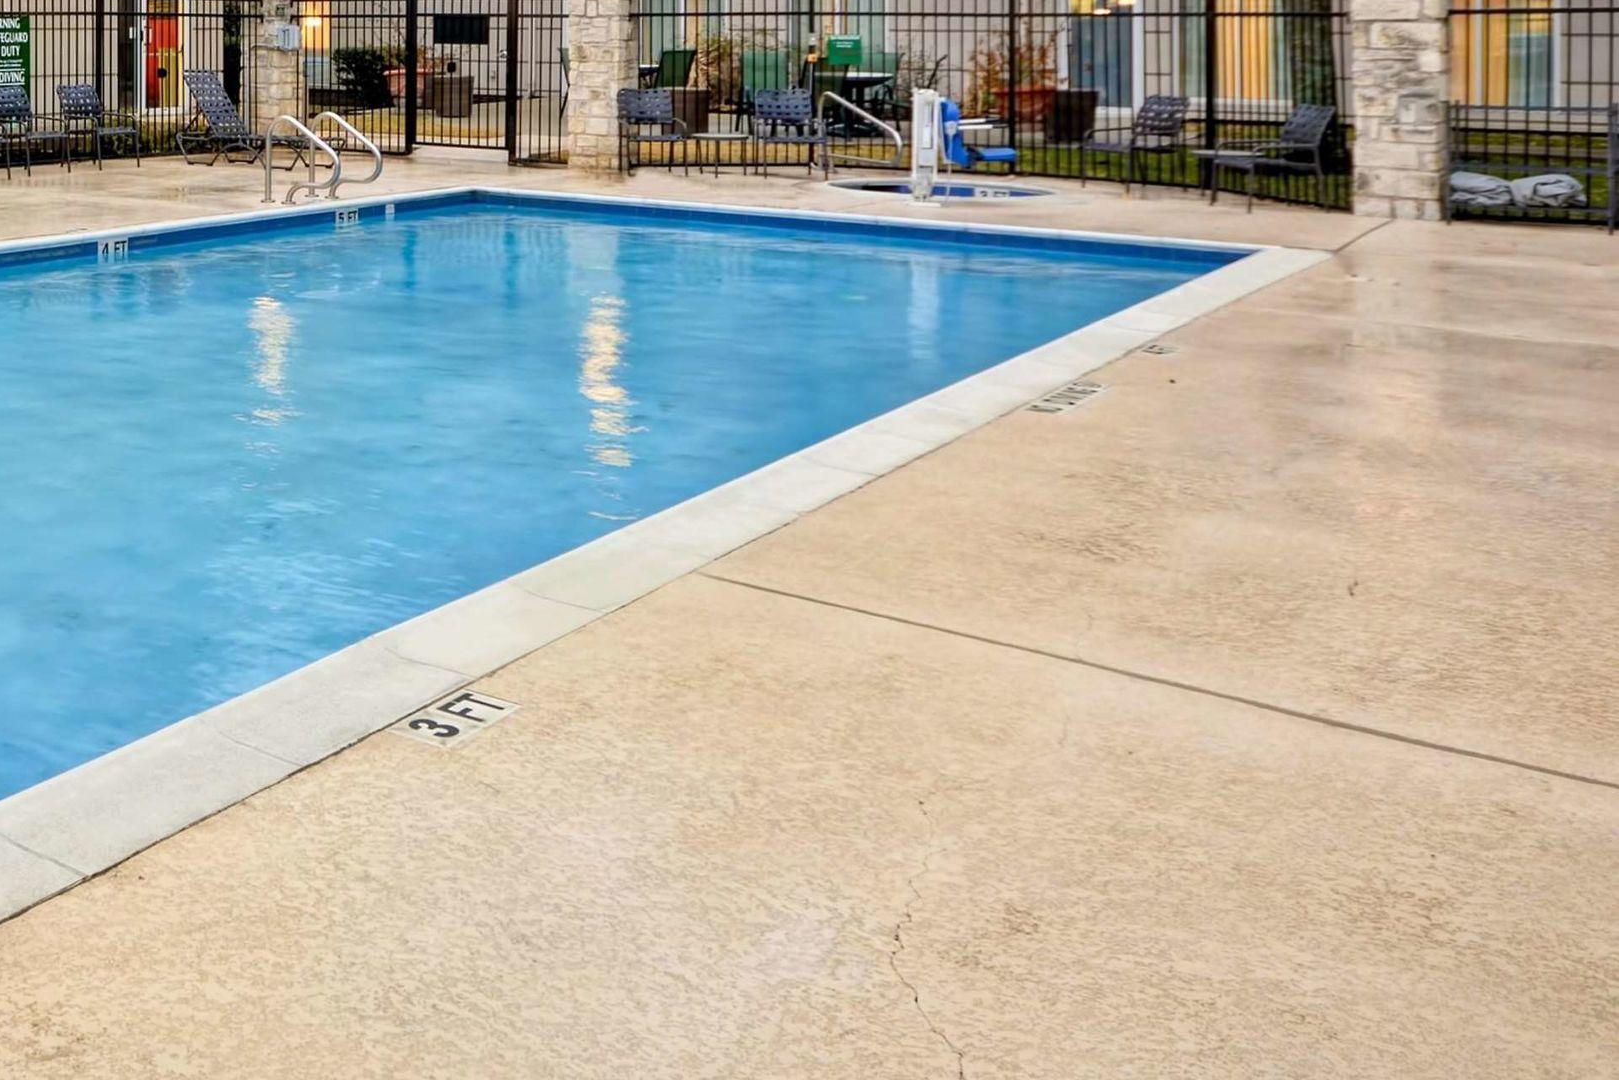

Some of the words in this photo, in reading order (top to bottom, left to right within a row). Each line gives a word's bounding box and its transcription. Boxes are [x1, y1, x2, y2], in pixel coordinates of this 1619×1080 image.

[1, 45, 21, 57] DUTY
[408, 718, 460, 738] 3
[436, 692, 506, 723] FT
